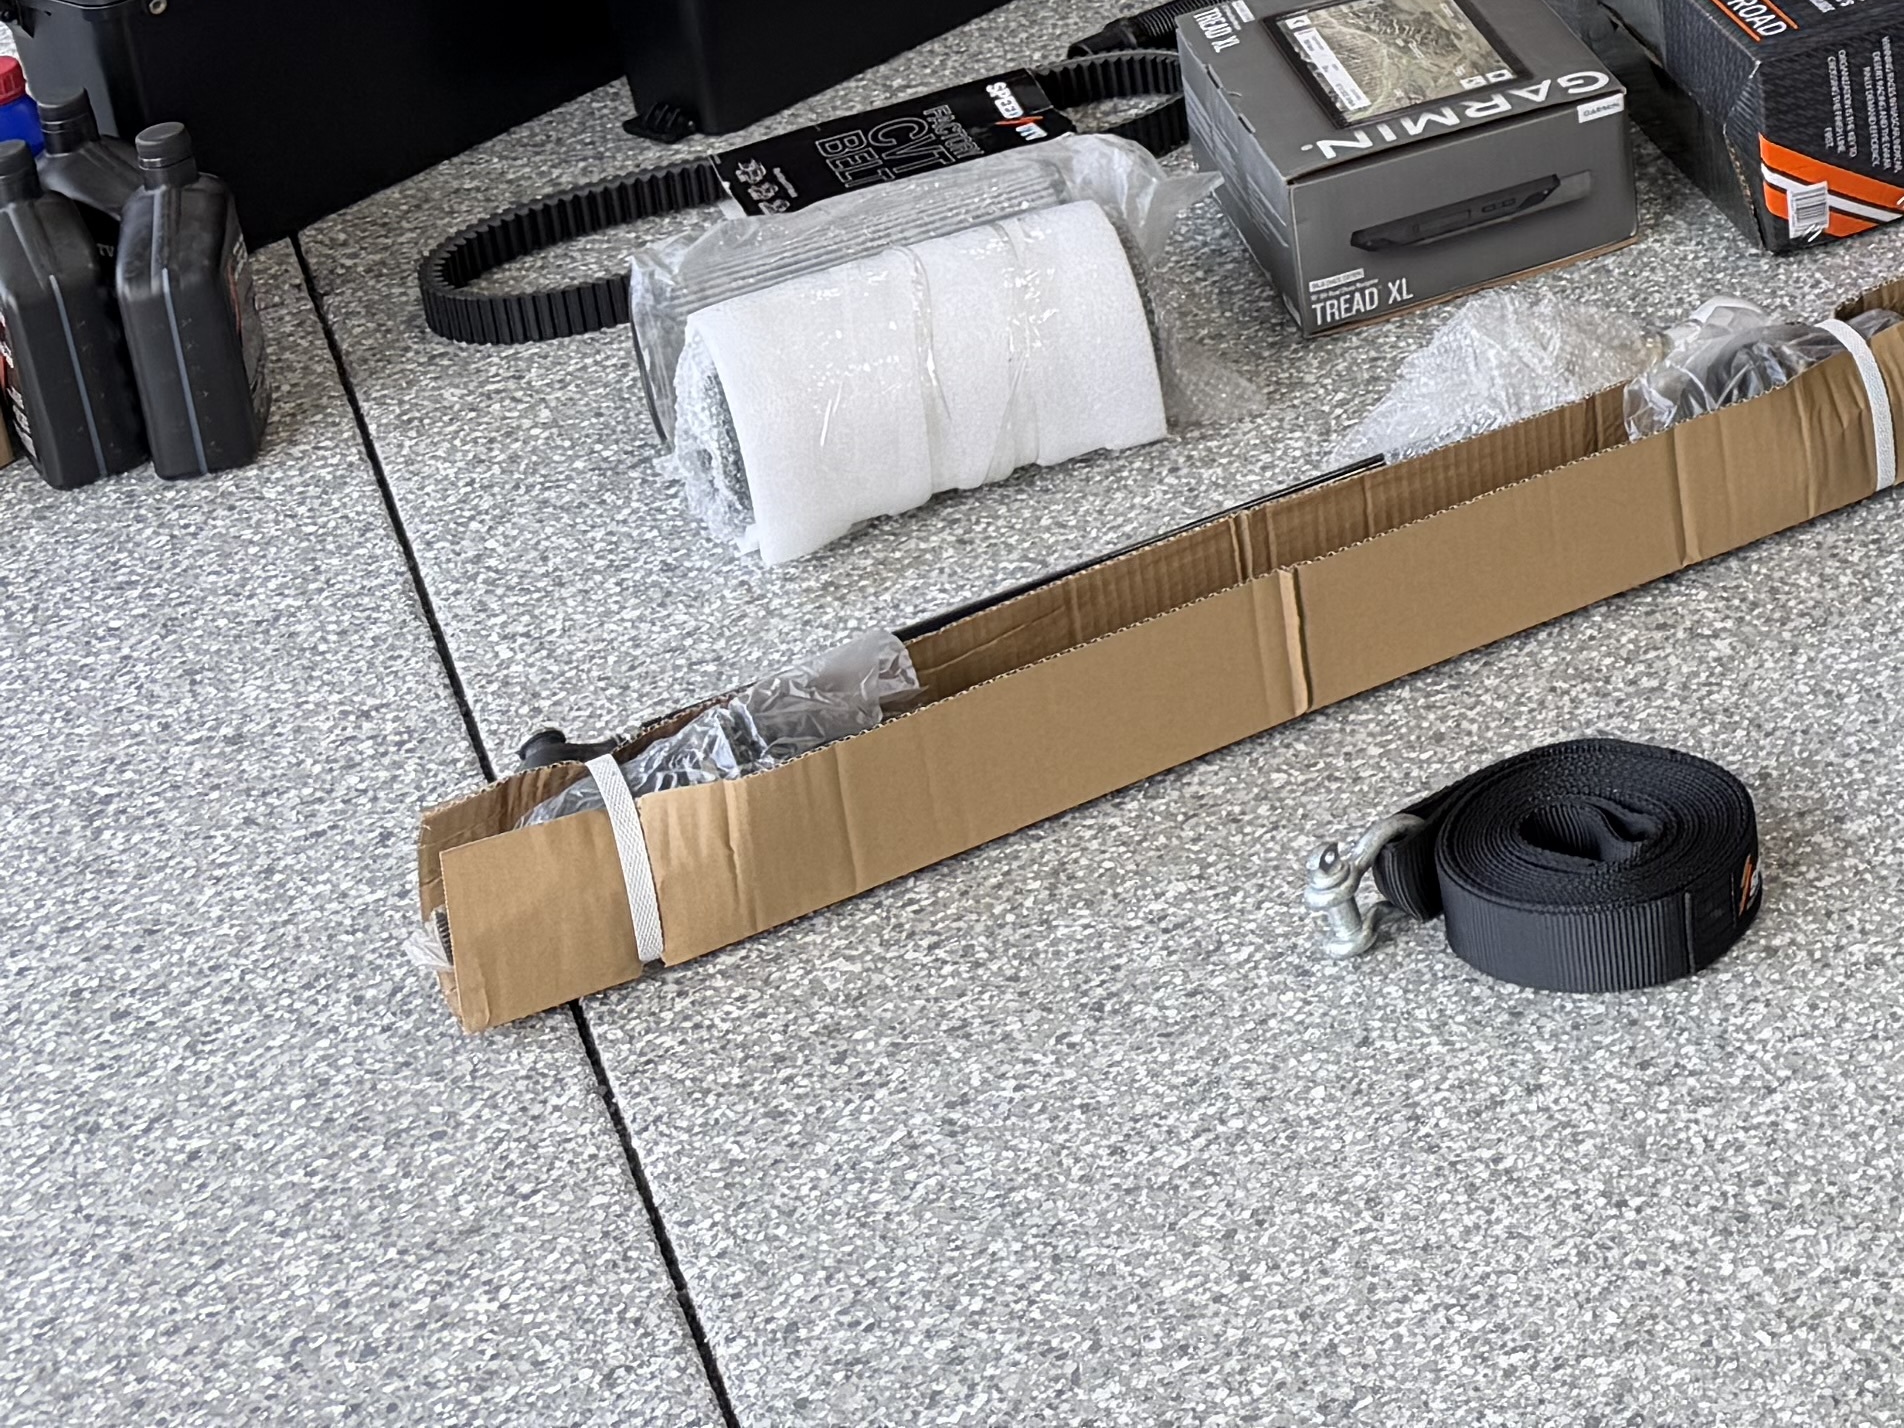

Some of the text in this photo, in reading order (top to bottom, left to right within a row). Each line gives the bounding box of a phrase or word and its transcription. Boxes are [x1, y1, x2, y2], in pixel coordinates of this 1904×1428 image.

[1193, 7, 1233, 39] TREAD
[1211, 34, 1240, 53] XL
[868, 116, 956, 173] CVT
[923, 104, 985, 159] FACTORY
[815, 129, 896, 188] BELT
[1311, 286, 1379, 326] TREAD
[1388, 277, 1414, 305] XL
